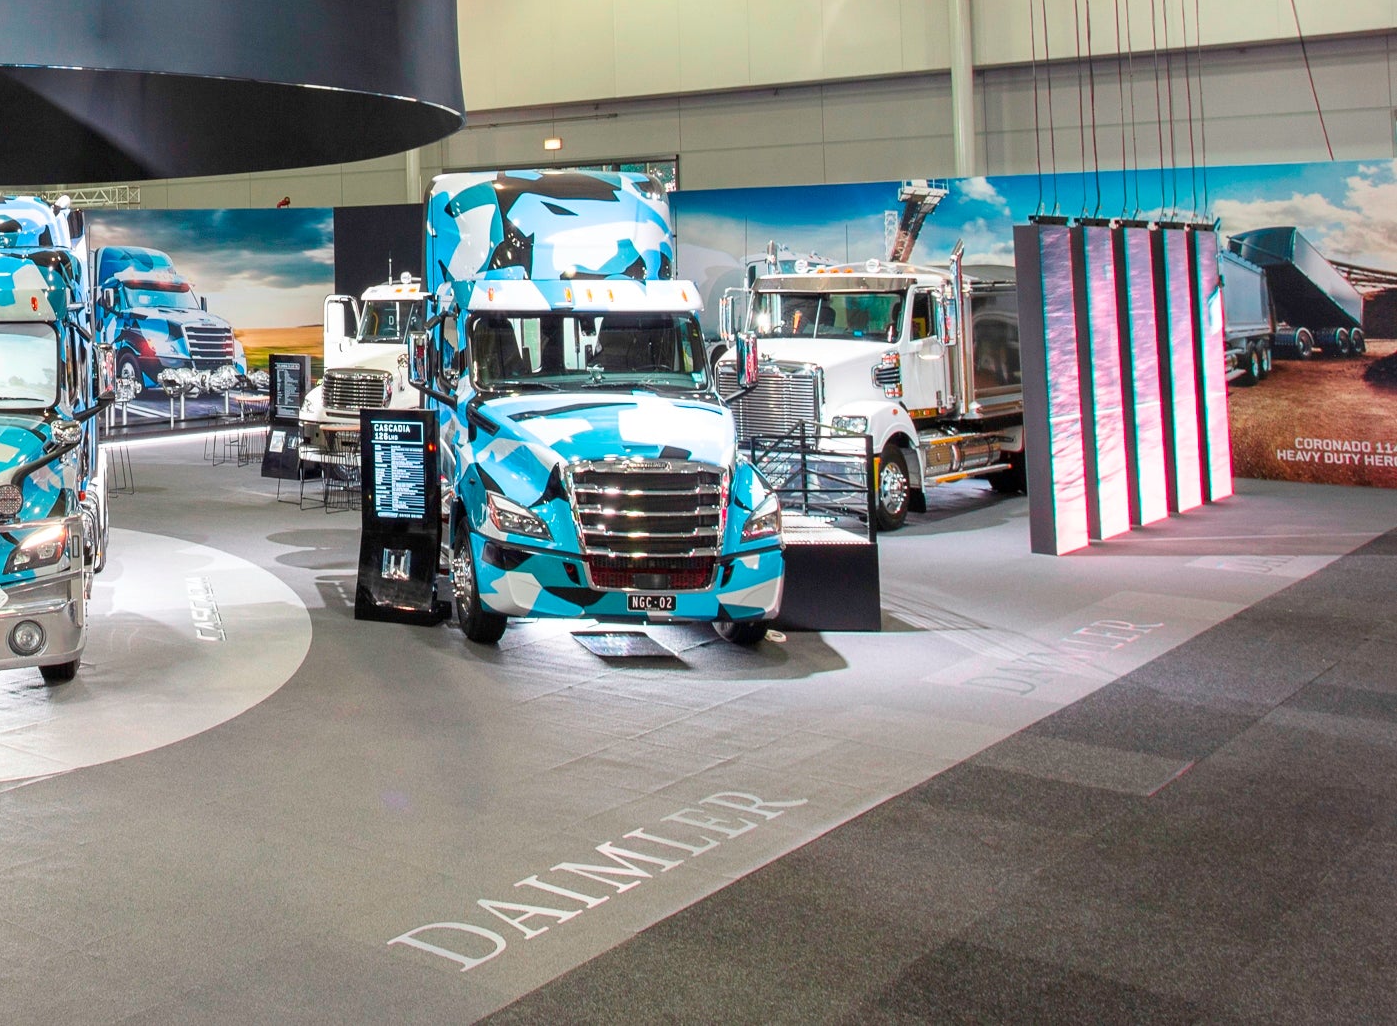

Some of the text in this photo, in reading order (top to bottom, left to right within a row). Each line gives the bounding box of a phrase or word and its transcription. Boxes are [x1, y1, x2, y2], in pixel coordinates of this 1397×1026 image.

[374, 423, 411, 433] CASCADIA
[1295, 437, 1371, 453] CORONADO
[1276, 449, 1320, 462] HEAVY
[1324, 452, 1360, 465] DUTY
[387, 786, 810, 972] DAIMLER
